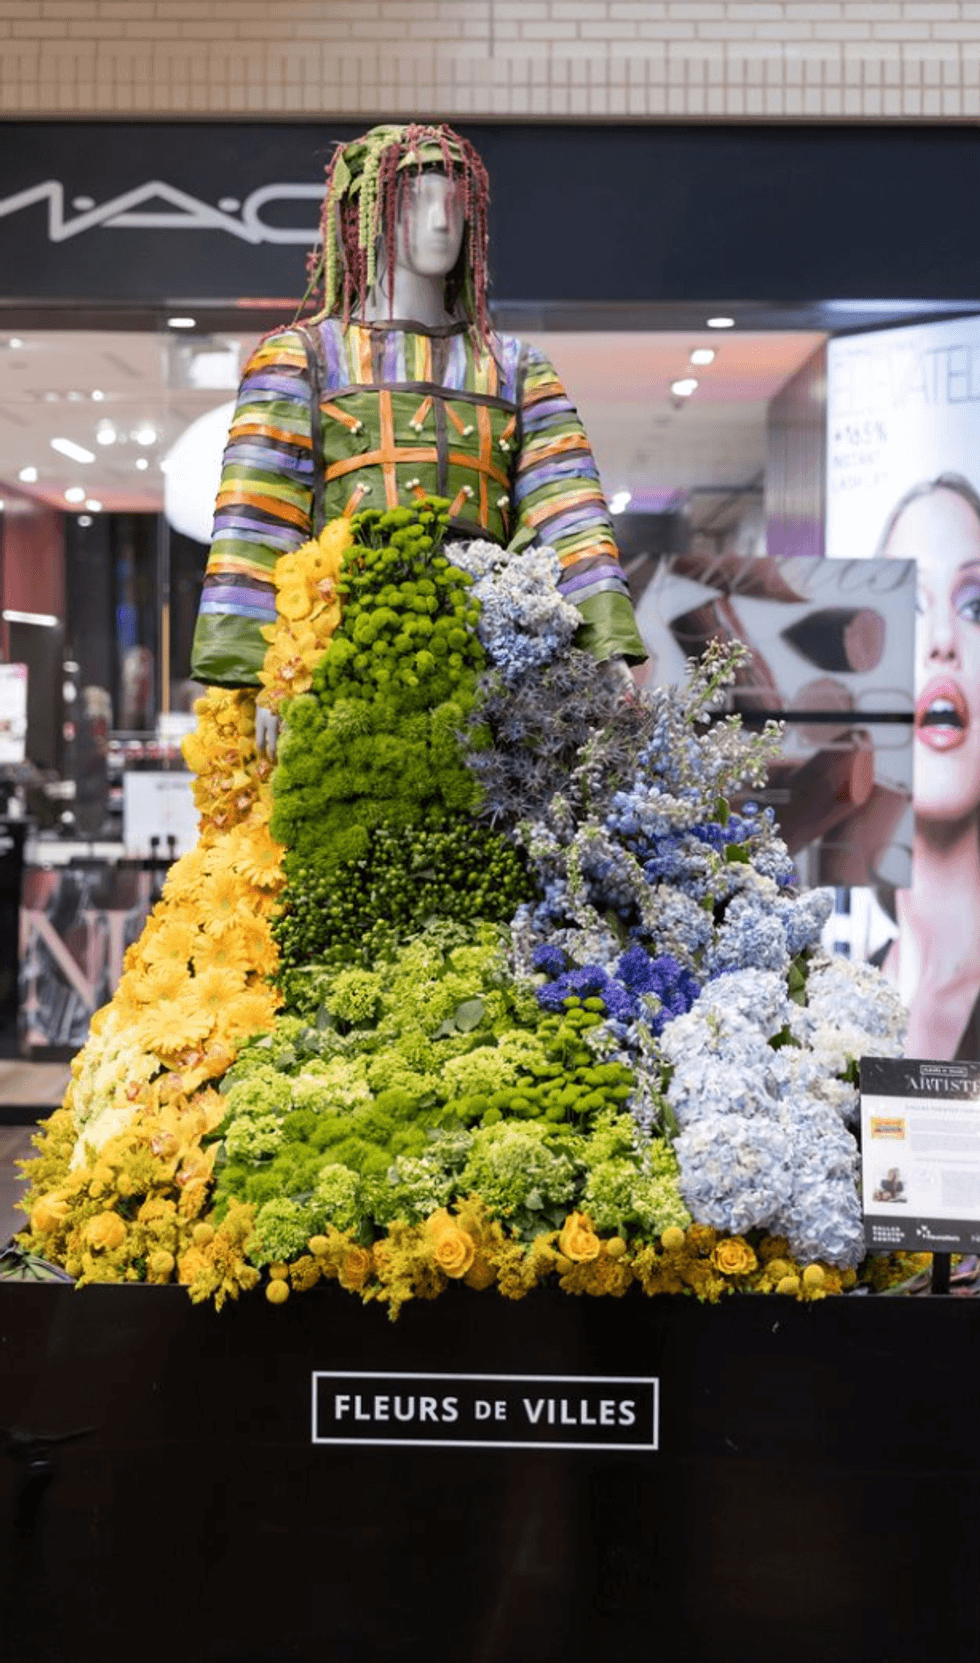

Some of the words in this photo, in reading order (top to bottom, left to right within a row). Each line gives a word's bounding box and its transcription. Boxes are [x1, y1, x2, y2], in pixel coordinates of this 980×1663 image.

[335, 1395, 459, 1422] FLEURS
[475, 1401, 507, 1420] DE
[524, 1399, 636, 1425] VILLES
